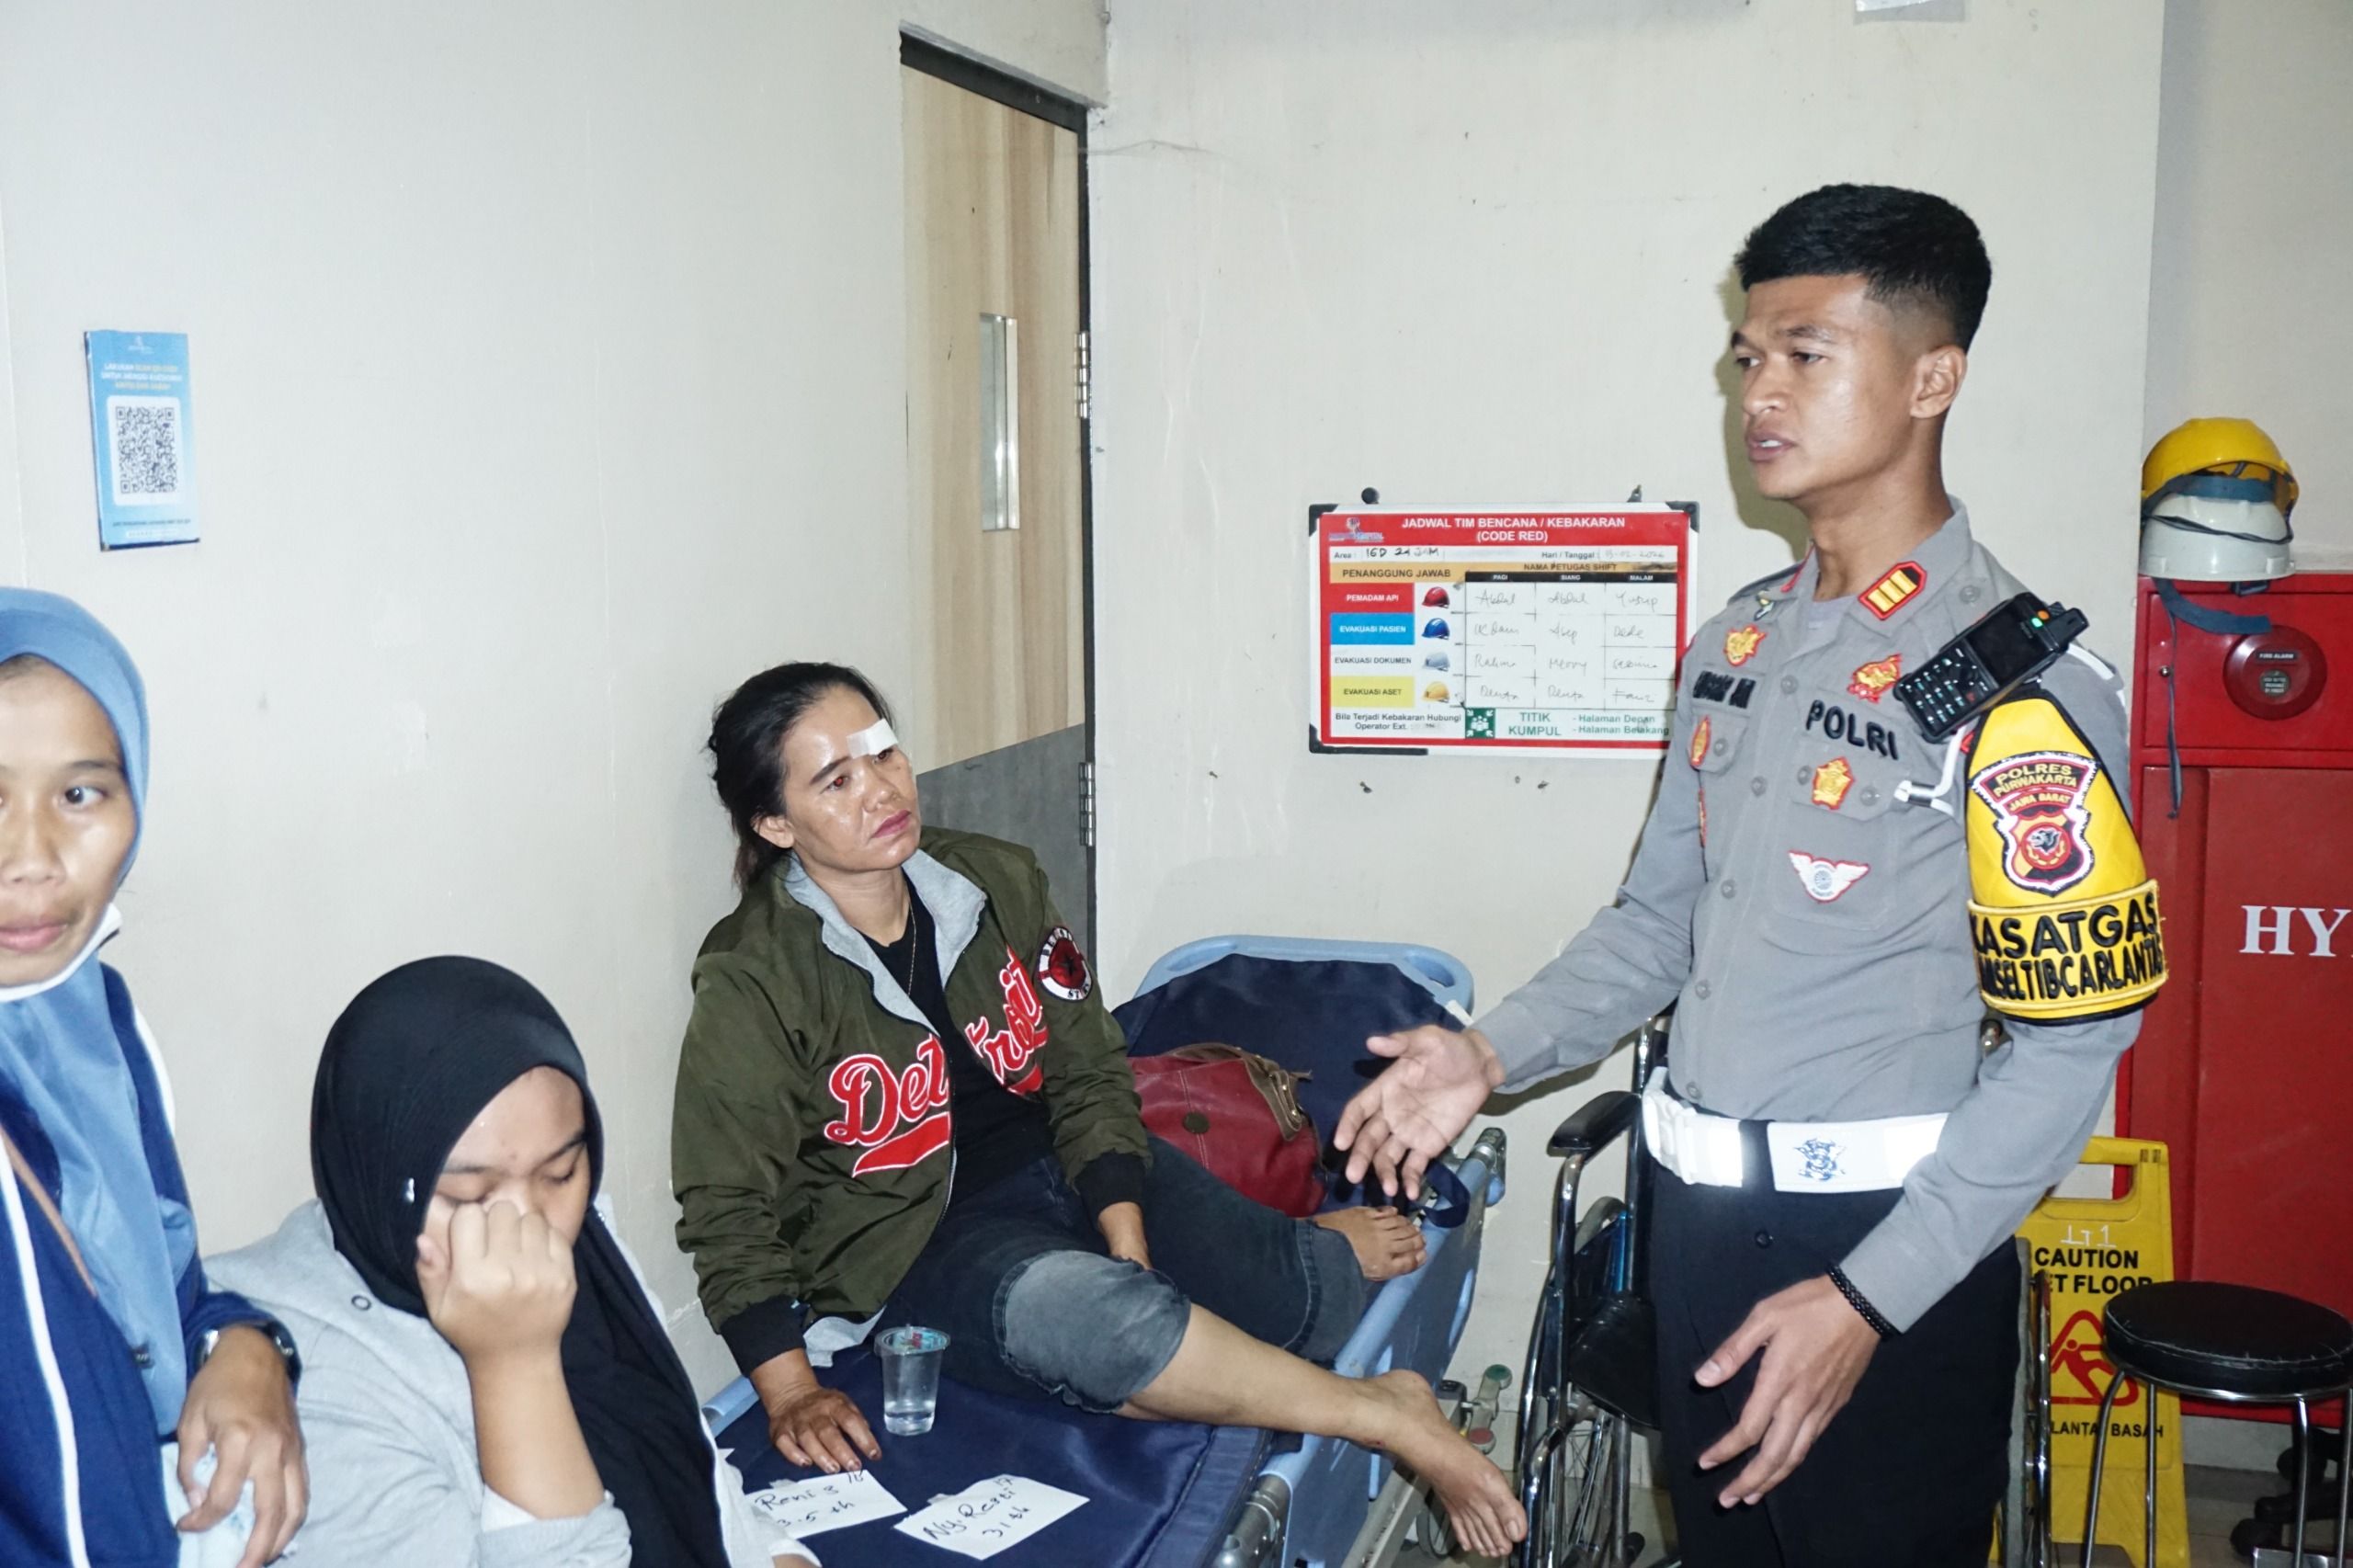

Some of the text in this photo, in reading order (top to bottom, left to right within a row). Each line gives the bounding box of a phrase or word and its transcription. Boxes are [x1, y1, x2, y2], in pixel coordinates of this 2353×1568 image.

[1402, 517, 1451, 528] JADWAL
[1454, 517, 1475, 528] TIM
[1478, 517, 1538, 528] BENCANA
[1547, 517, 1625, 528] KEBAKARAN
[1476, 530, 1549, 542] (CODE RED)
[1565, 551, 1595, 561] Tanggal
[1551, 562, 1591, 571] PETUGAS
[1342, 569, 1451, 578] PENANGGUNG JAWAB
[1346, 594, 1399, 602] PEMADAM API
[1339, 625, 1406, 633] EVAKUASI PASIEN
[1353, 713, 1381, 722] Terjadi
[1381, 713, 1424, 722] Kebakaran
[1427, 713, 1461, 723] Hubungi
[1519, 712, 1551, 722] TITIK
[1623, 715, 1655, 725] Depan
[1355, 722, 1391, 732] Operator
[1507, 726, 1562, 736] KUMPUL
[1623, 726, 1669, 736] Belakang
[1805, 699, 1899, 761] POLRI
[1995, 763, 2073, 787] POLRES
[1993, 774, 2078, 798] PURWAKARTA
[2009, 792, 2072, 812] JAWA BARAT
[2034, 1247, 2140, 1269] CAUTION
[2050, 1421, 2097, 1436] LANTA
